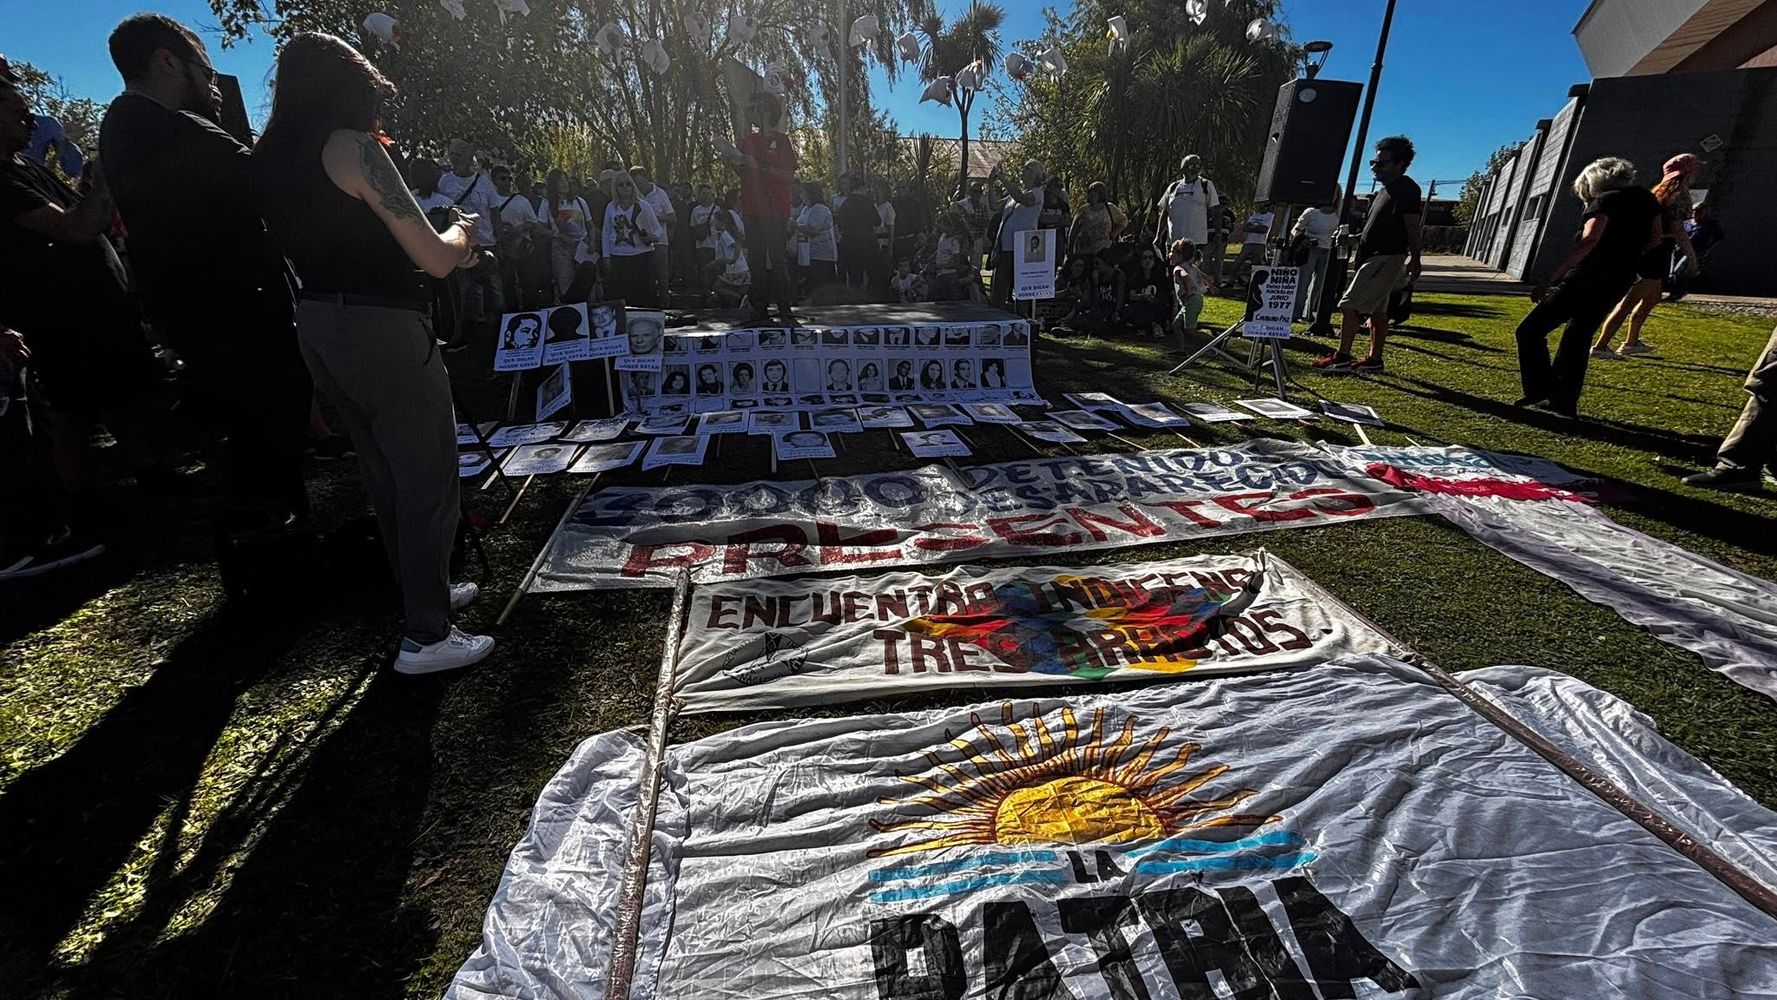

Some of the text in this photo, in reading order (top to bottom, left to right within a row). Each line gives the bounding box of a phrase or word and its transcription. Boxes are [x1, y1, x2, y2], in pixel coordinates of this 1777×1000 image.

[1269, 301, 1292, 309] 1977
[706, 580, 1001, 629] ENCUENTRO
[872, 628, 1031, 676] TRES
[1066, 849, 1130, 884] LA
[868, 875, 1423, 1000] PATRIA
